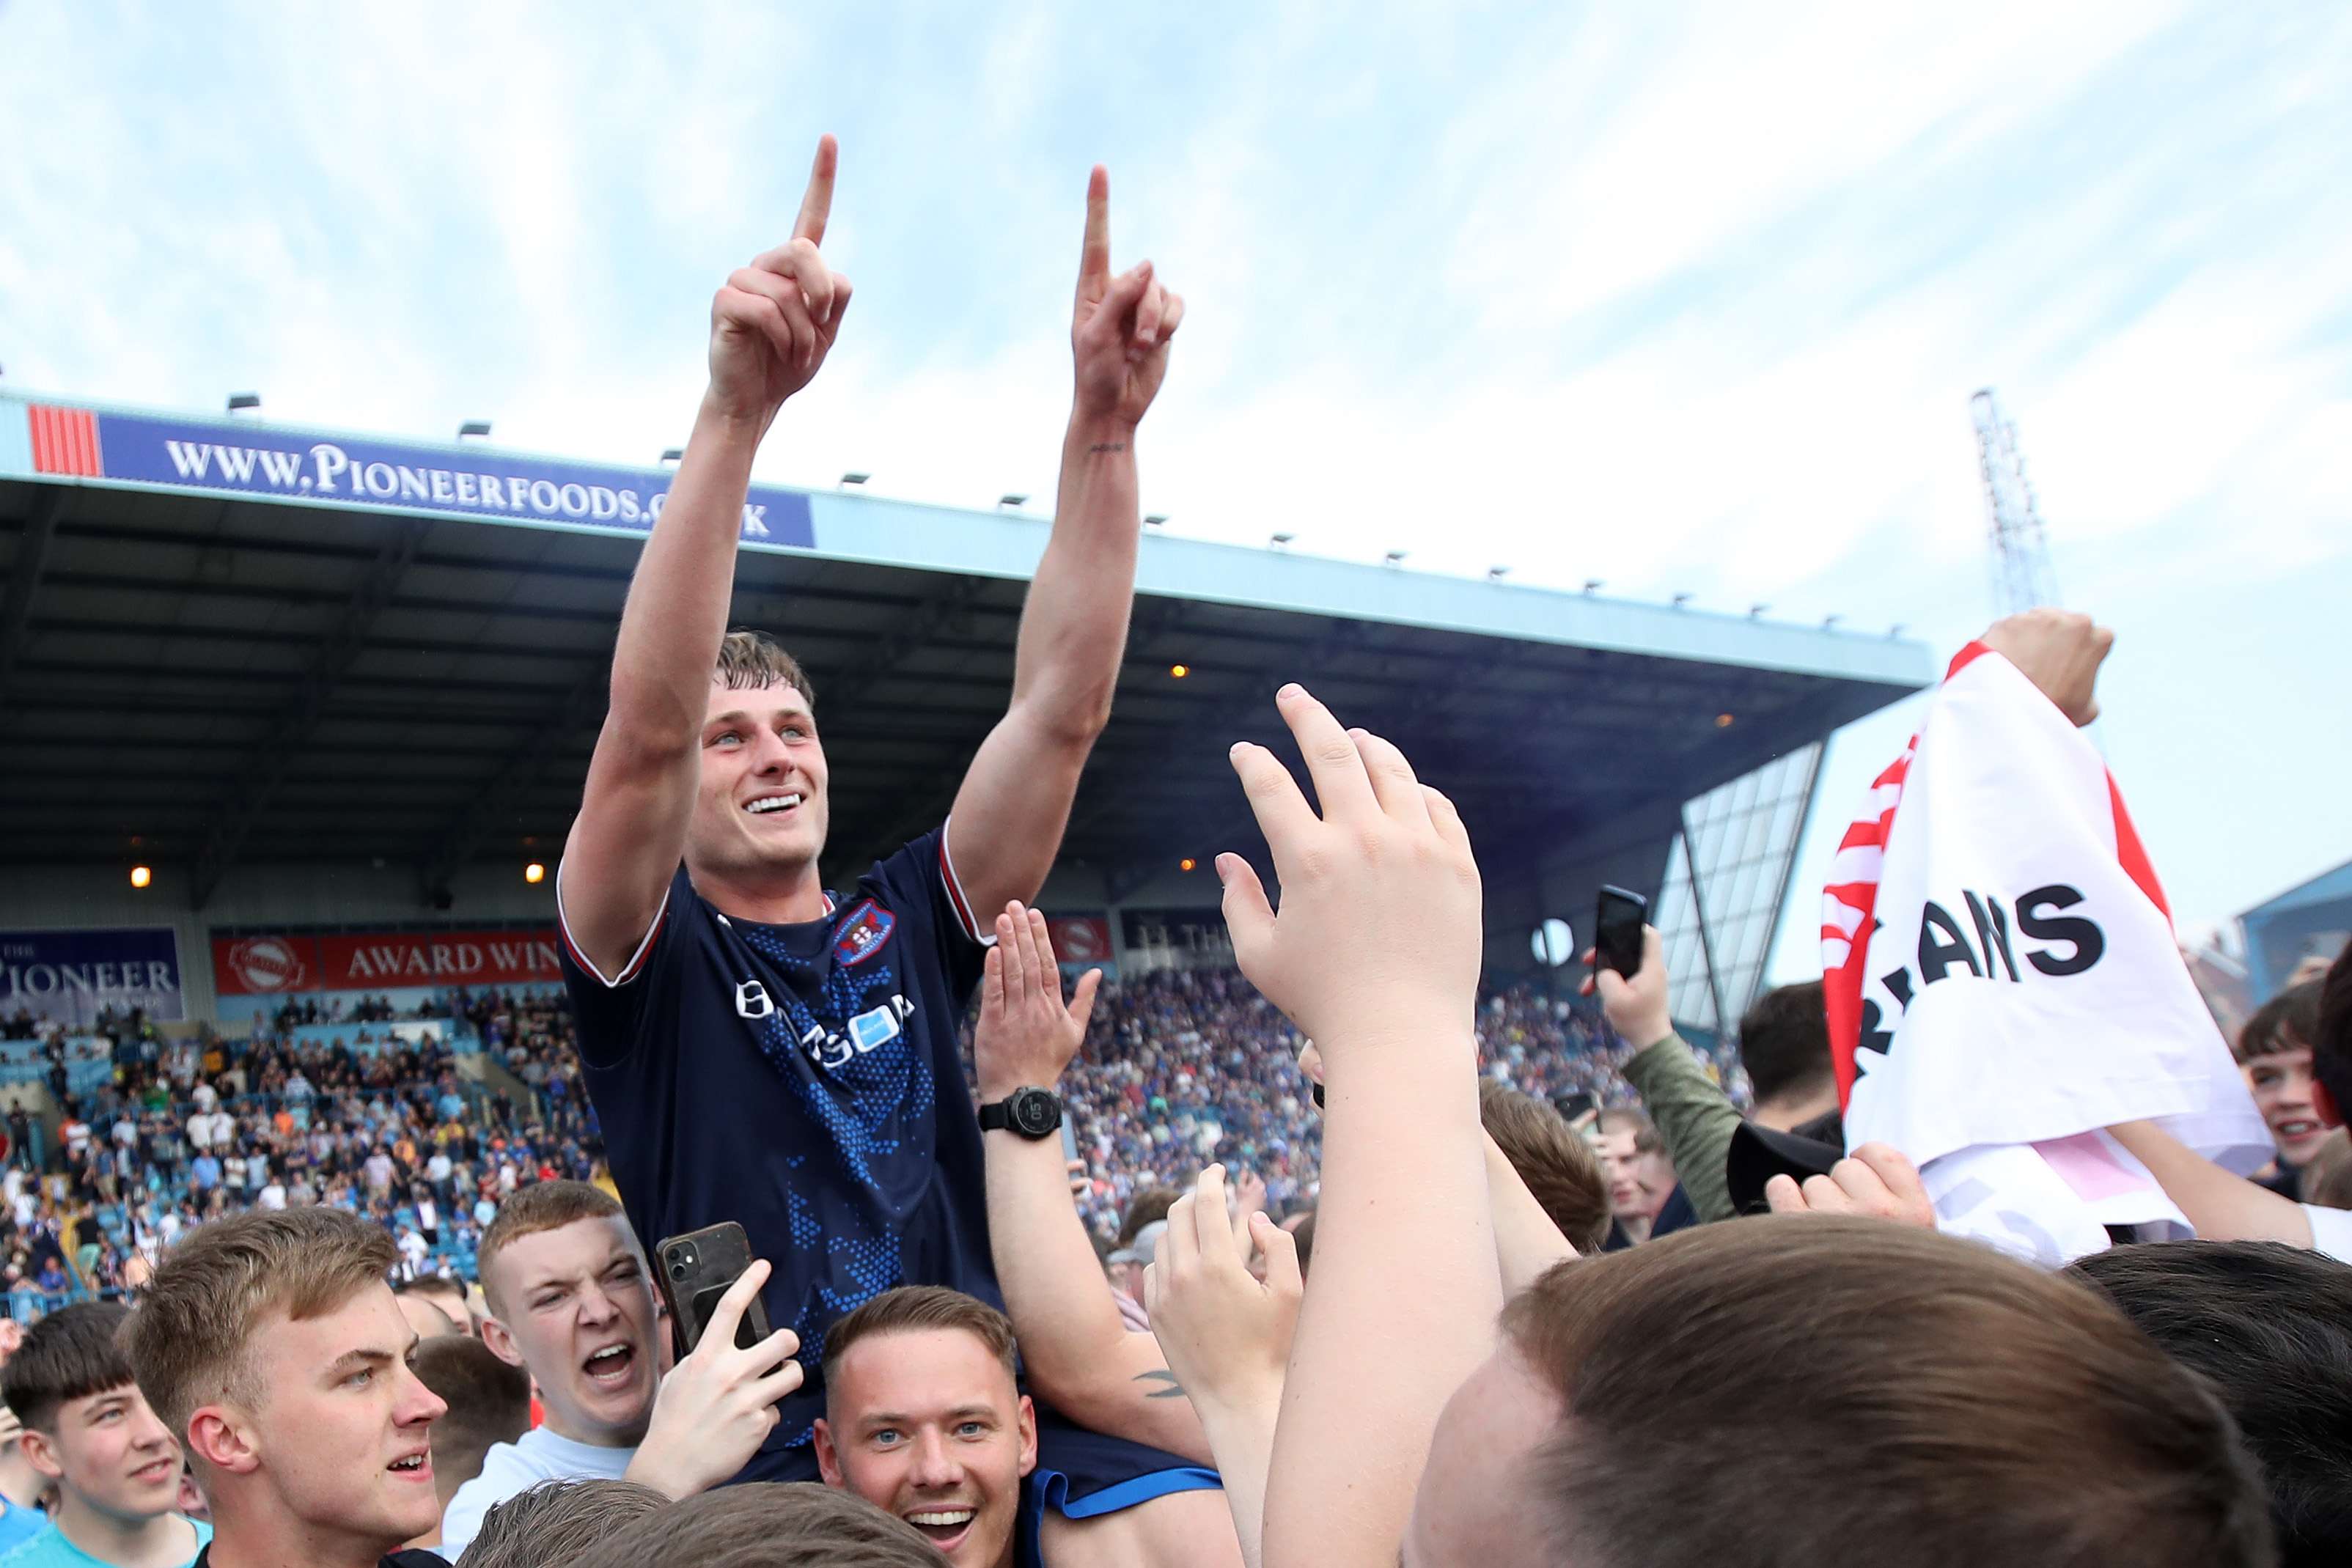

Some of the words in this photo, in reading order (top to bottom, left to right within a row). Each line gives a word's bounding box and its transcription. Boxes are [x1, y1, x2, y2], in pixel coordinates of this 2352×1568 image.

[165, 440, 771, 537] WWW.PIONEERFOODS.K
[0, 959, 175, 998] IONEER
[348, 942, 485, 978] AWARD
